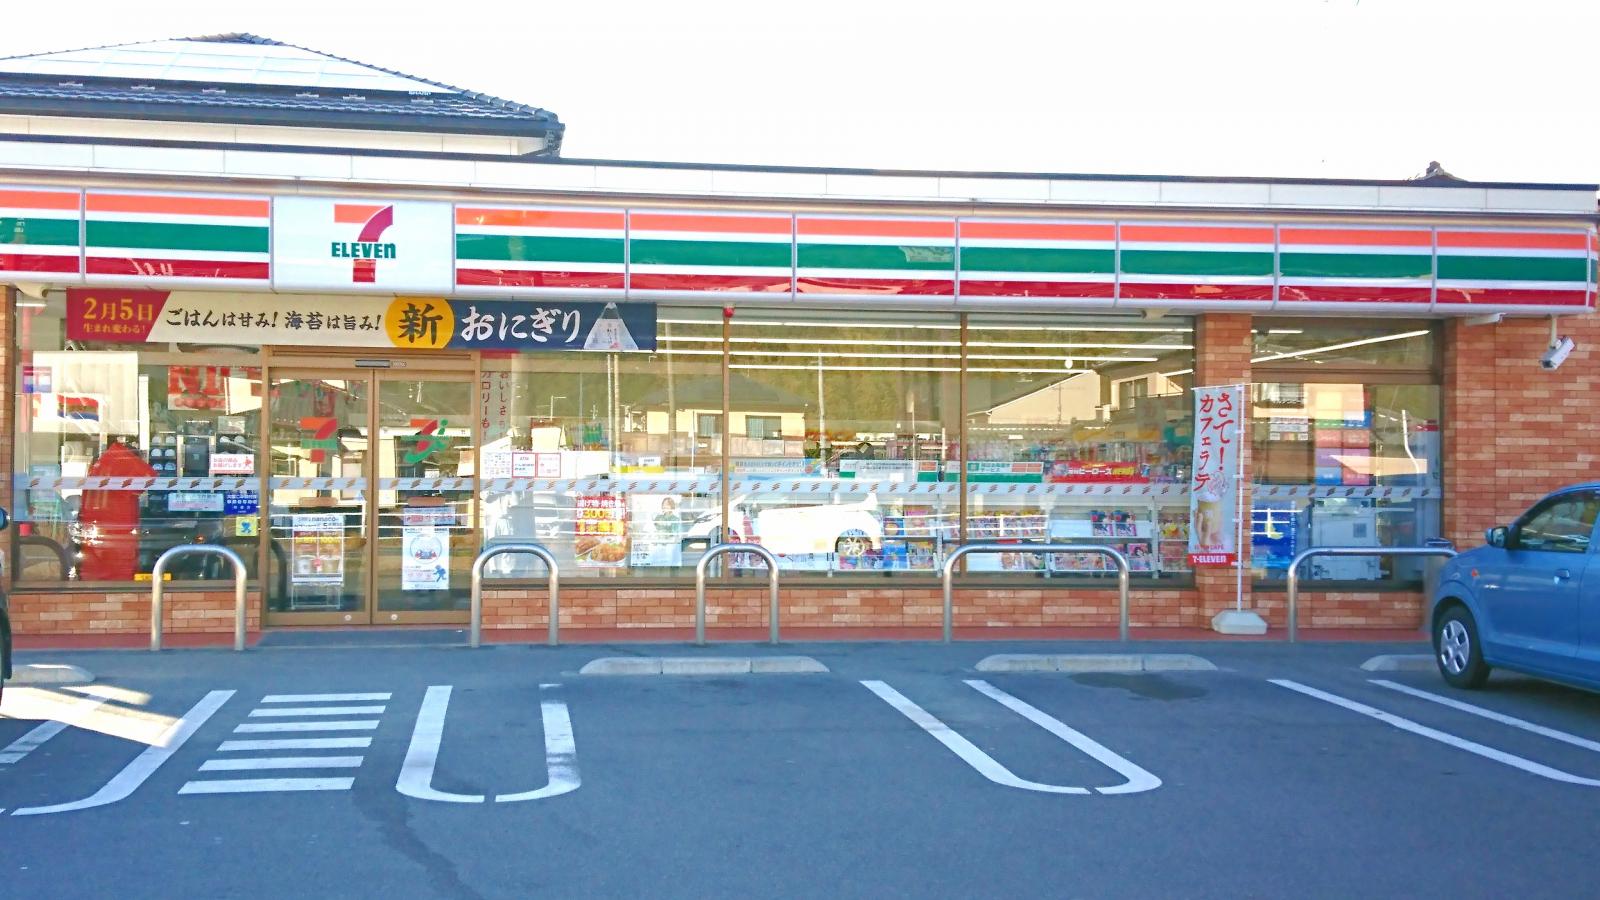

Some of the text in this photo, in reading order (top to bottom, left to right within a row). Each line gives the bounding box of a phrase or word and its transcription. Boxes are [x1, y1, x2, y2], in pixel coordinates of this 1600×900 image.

[83, 297, 153, 321] 2月5日
[83, 323, 146, 334] 生まれ変わる!
[165, 307, 279, 328] ごはんは甘み!
[284, 310, 382, 331] 海苔は旨み!
[397, 303, 443, 345] 新
[461, 306, 581, 344] おにぎり
[1193, 393, 1215, 492] カフェラテ
[1213, 392, 1235, 471] さて!
